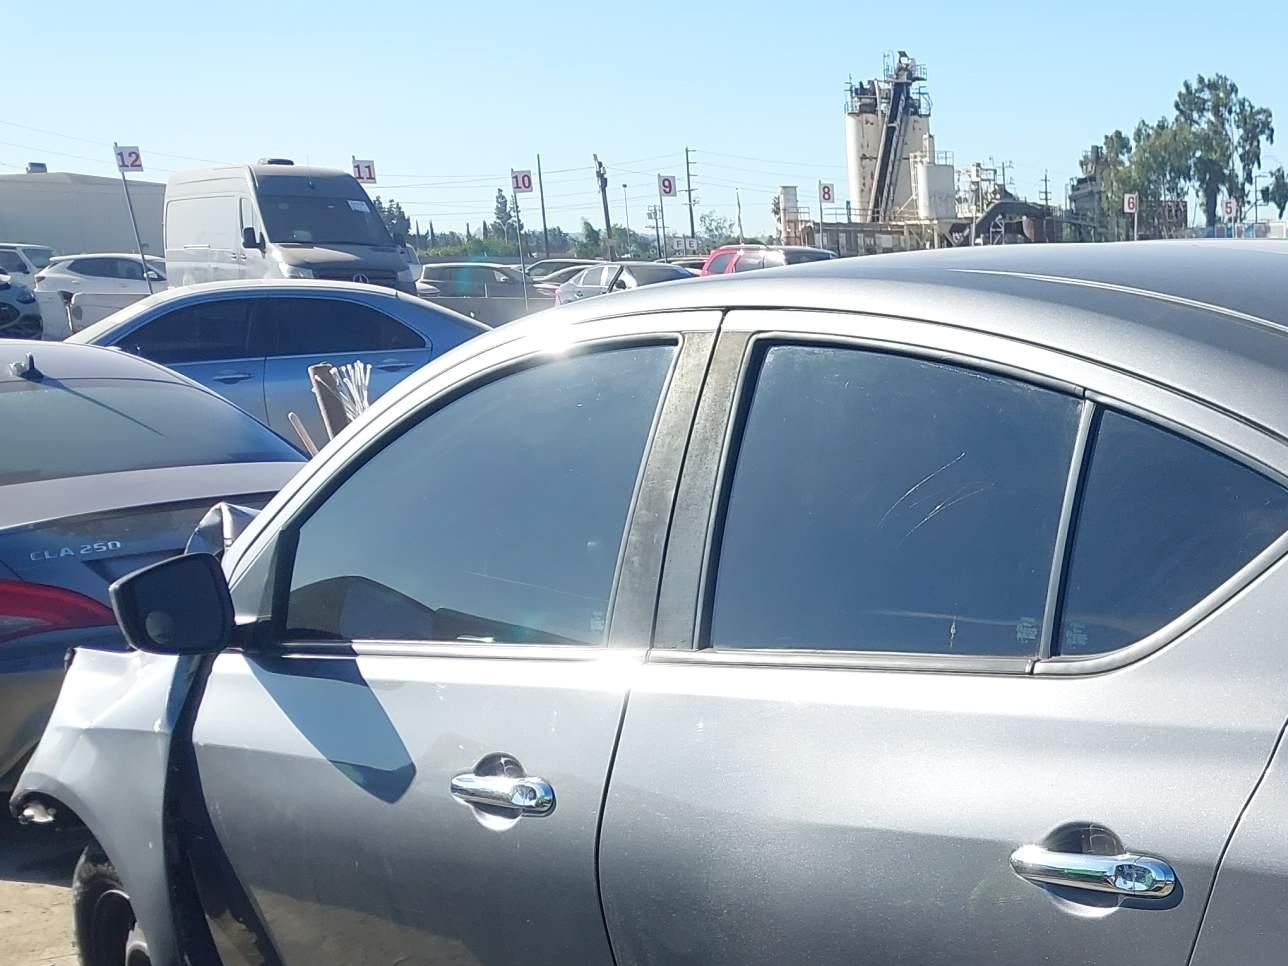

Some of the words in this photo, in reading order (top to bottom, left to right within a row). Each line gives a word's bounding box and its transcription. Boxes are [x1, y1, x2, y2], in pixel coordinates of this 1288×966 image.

[117, 150, 142, 168] 12
[353, 165, 376, 181] 11
[513, 173, 532, 190] 10
[662, 178, 672, 195] 9
[822, 185, 832, 201] 8
[1127, 196, 1136, 210] 6
[1224, 201, 1233, 215] 5
[30, 546, 75, 562] CLA
[80, 540, 121, 555] 250
